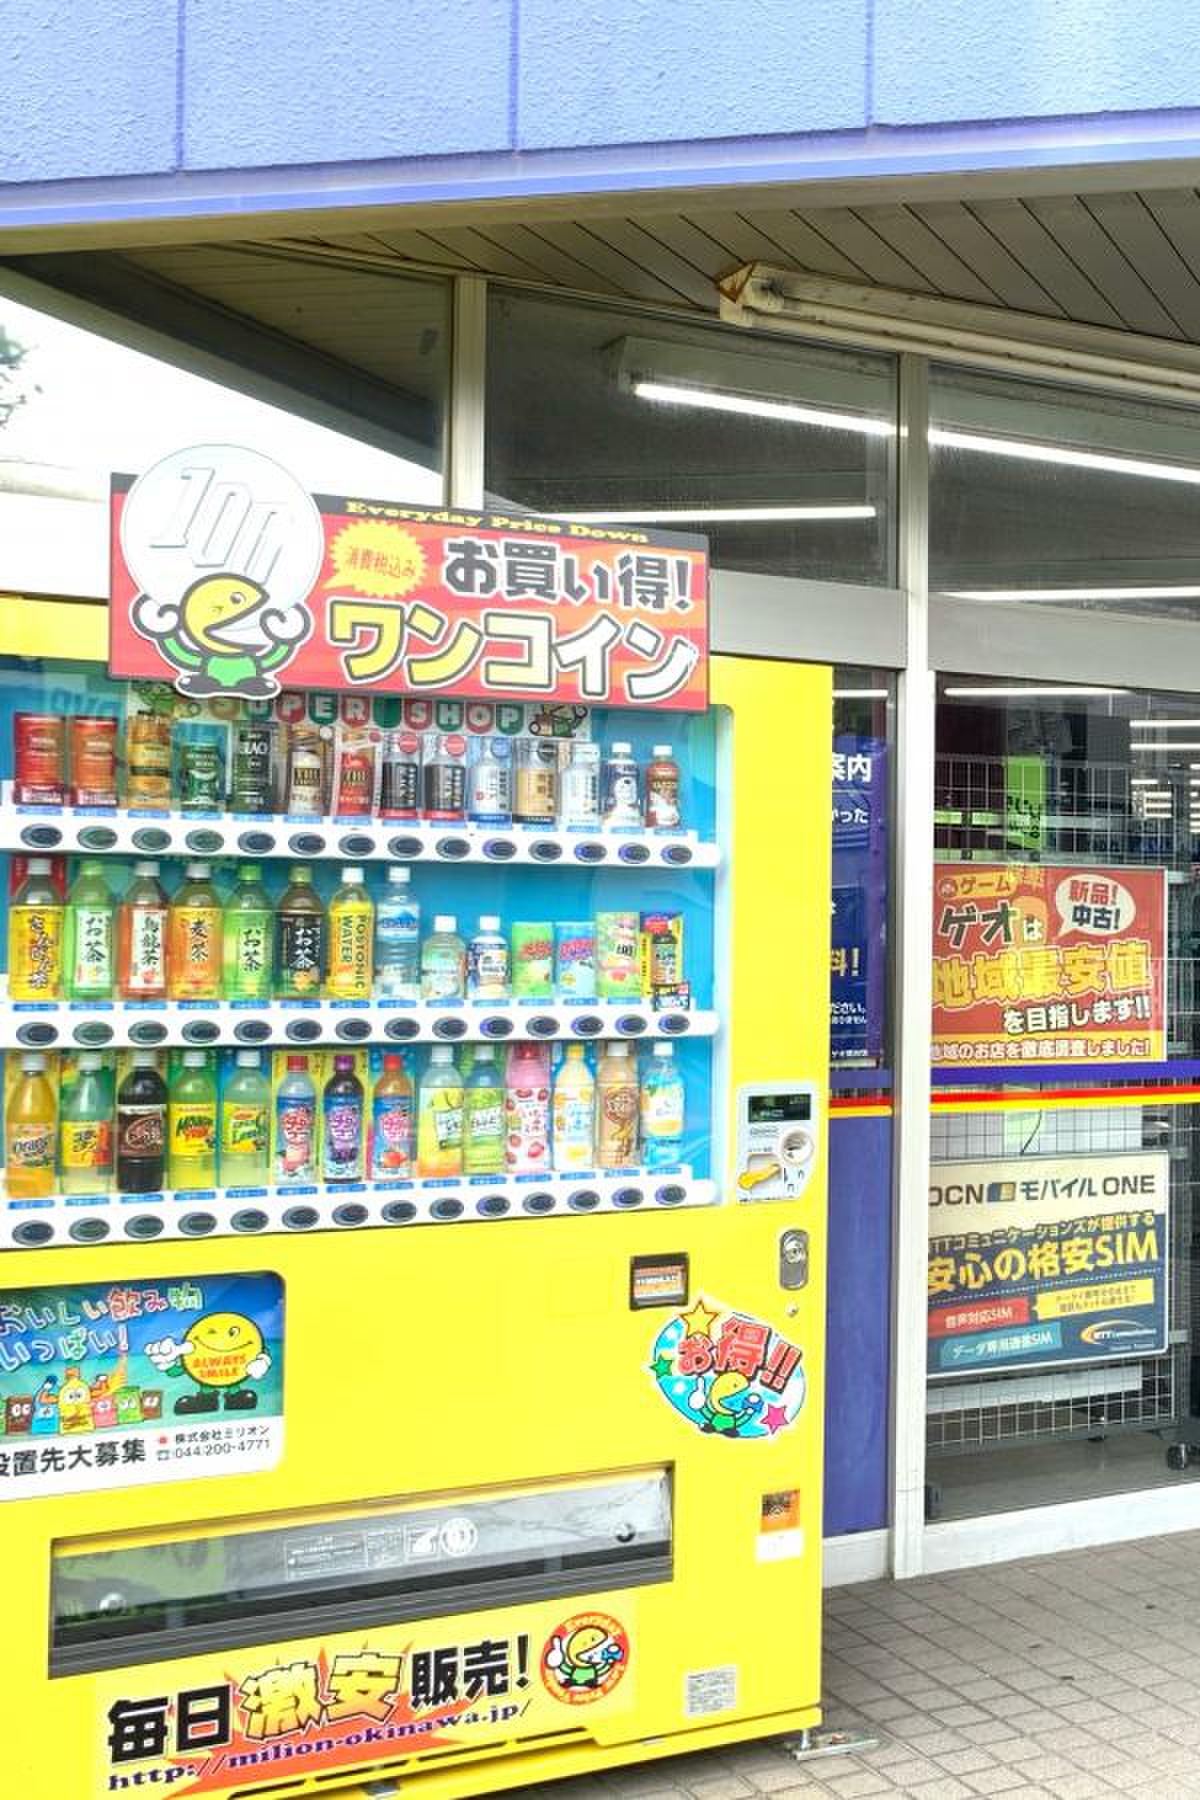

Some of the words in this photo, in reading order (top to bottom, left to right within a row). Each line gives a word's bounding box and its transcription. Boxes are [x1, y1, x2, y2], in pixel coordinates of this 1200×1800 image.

[346, 501, 481, 528] Everyday
[489, 516, 561, 534] Price
[569, 524, 649, 543] Down
[345, 547, 416, 579] 消費税込み
[444, 538, 692, 609] お買い得!
[330, 600, 698, 698] ワンコイン
[1069, 880, 1118, 906] 新品!
[85, 917, 106, 962] お茶
[1072, 906, 1121, 931] 中古!
[289, 928, 316, 970] お茶
[1003, 995, 1151, 1035] を目指します!!
[928, 1230, 1158, 1294] 安心の格安SIM
[175, 1425, 270, 1445] 株式会社ミリオン
[108, 1633, 531, 1763] 毎日激安販売!
[108, 1697, 532, 1791] http://milion-okinawa.jp/
